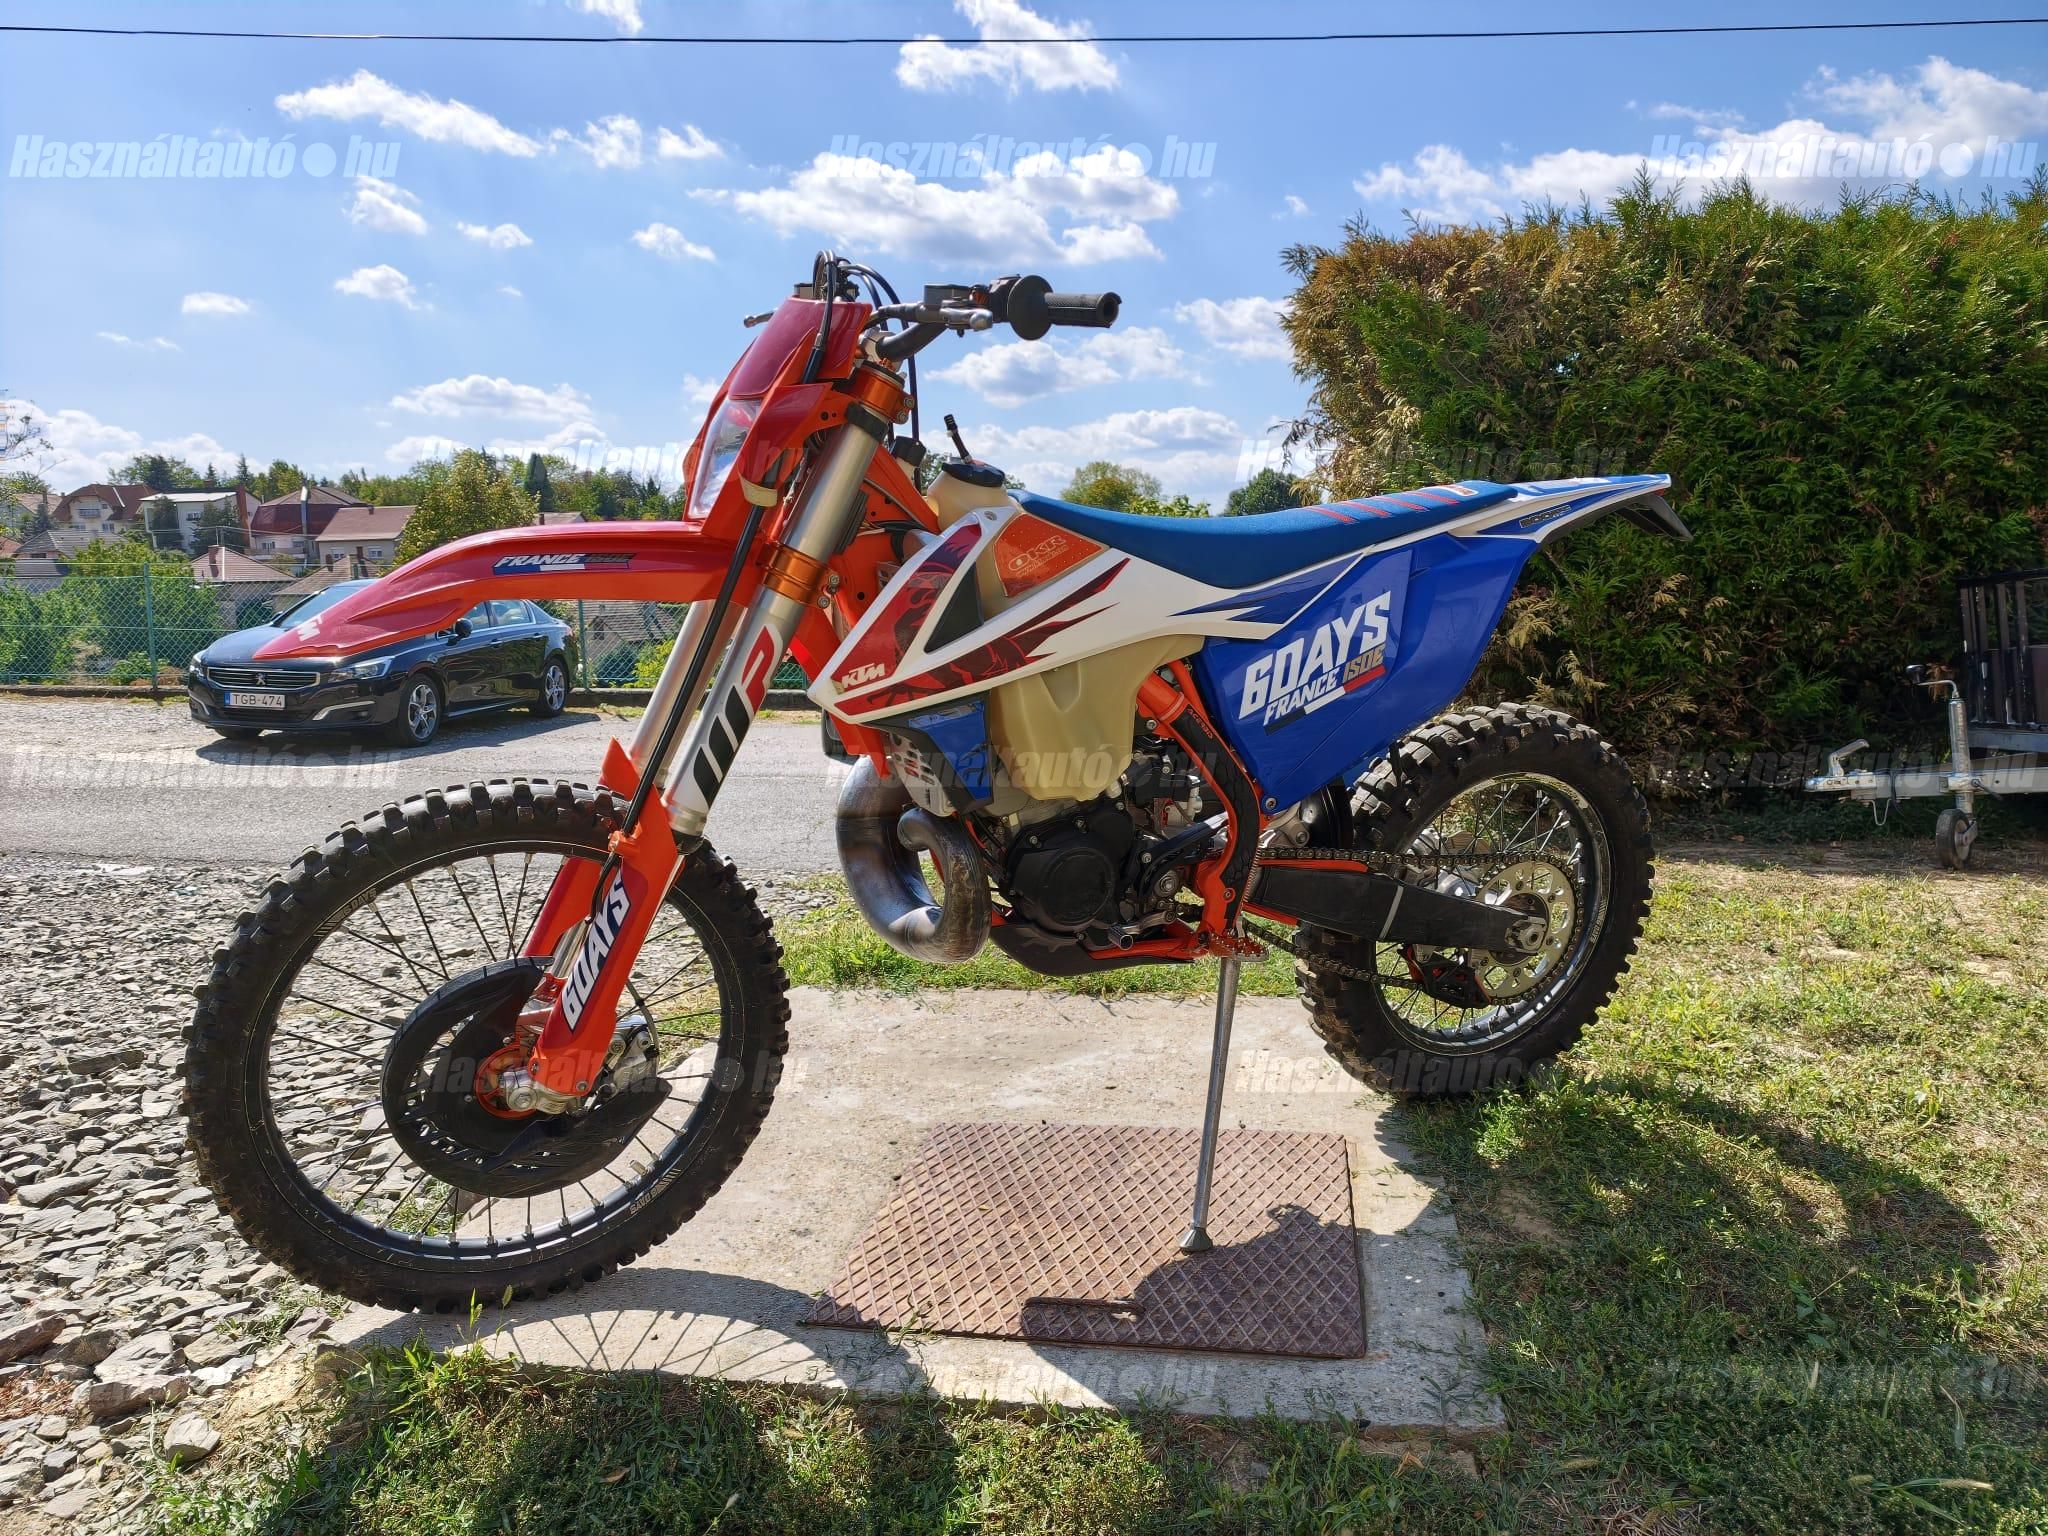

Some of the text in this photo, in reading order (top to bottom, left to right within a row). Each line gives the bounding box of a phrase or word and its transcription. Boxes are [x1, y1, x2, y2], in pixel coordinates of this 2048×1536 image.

[495, 553, 586, 568] FRANCE
[841, 663, 886, 689] KTM
[1263, 643, 1386, 727] FRANCE ISDE
[233, 694, 283, 707] TGB-474
